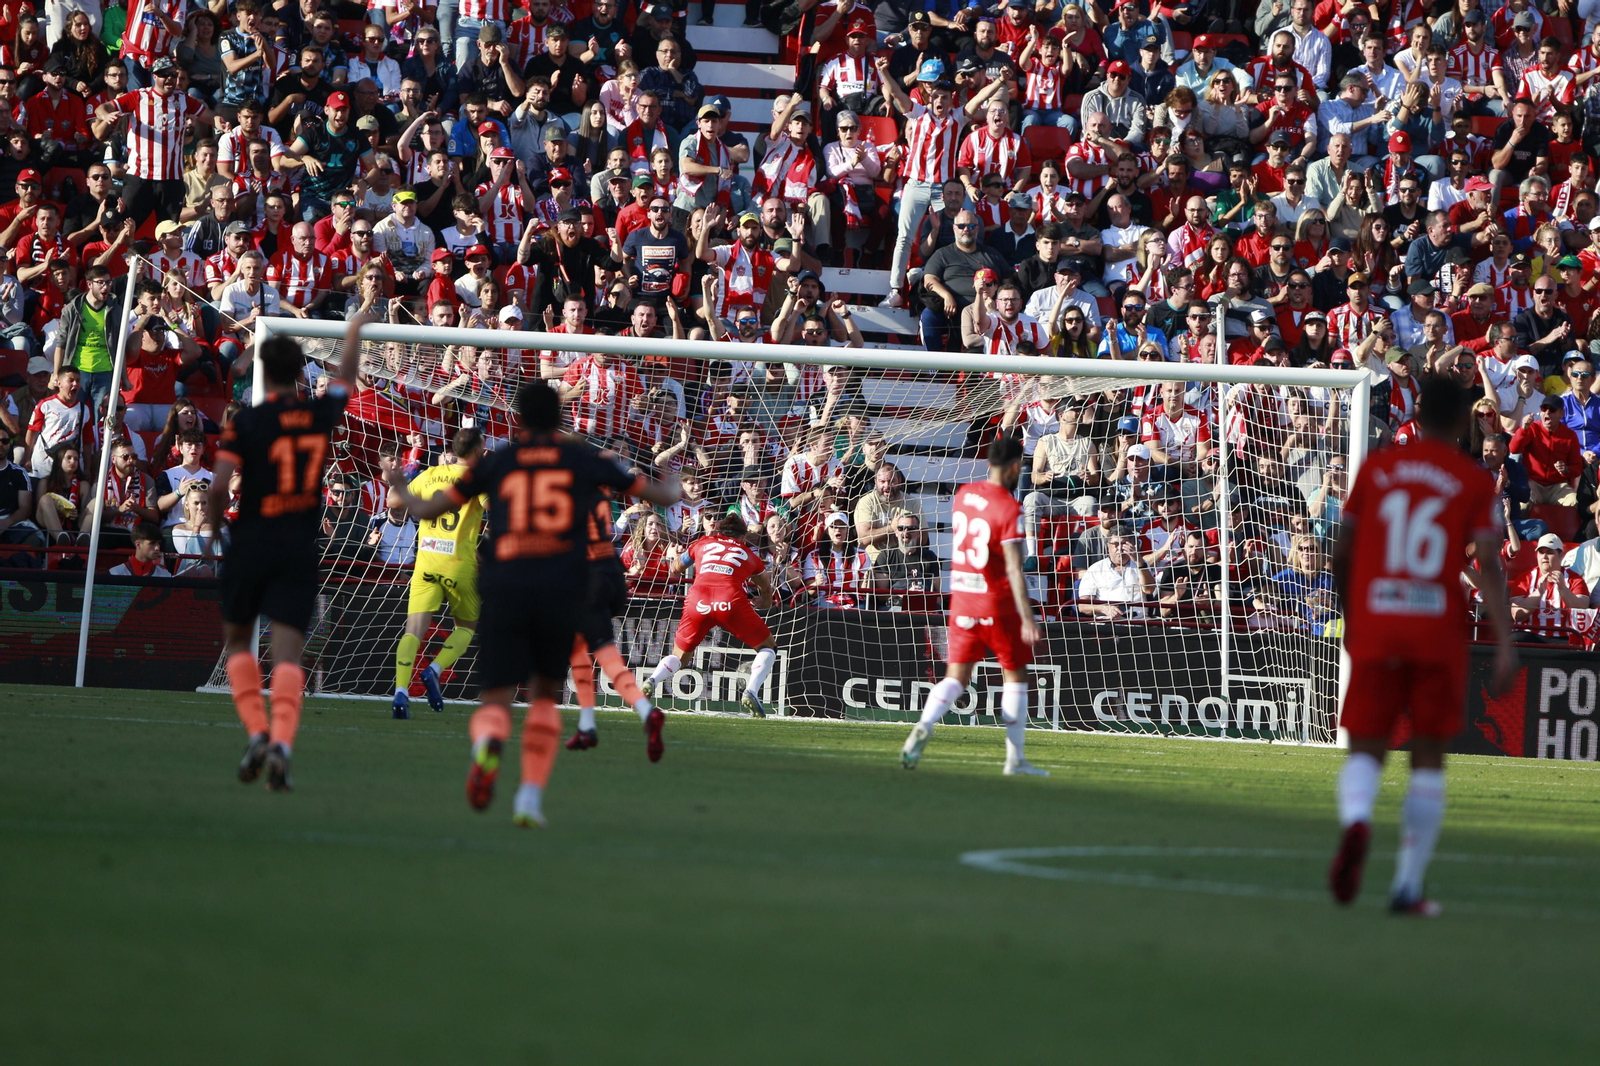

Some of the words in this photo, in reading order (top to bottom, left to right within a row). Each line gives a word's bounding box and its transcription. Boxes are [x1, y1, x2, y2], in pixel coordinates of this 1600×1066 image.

[267, 433, 329, 496] 17
[498, 469, 574, 533] 15
[701, 542, 748, 567] 22
[952, 511, 991, 570] 23
[1378, 489, 1448, 579] 16
[436, 573, 458, 589] TCI
[711, 601, 731, 612] TCI
